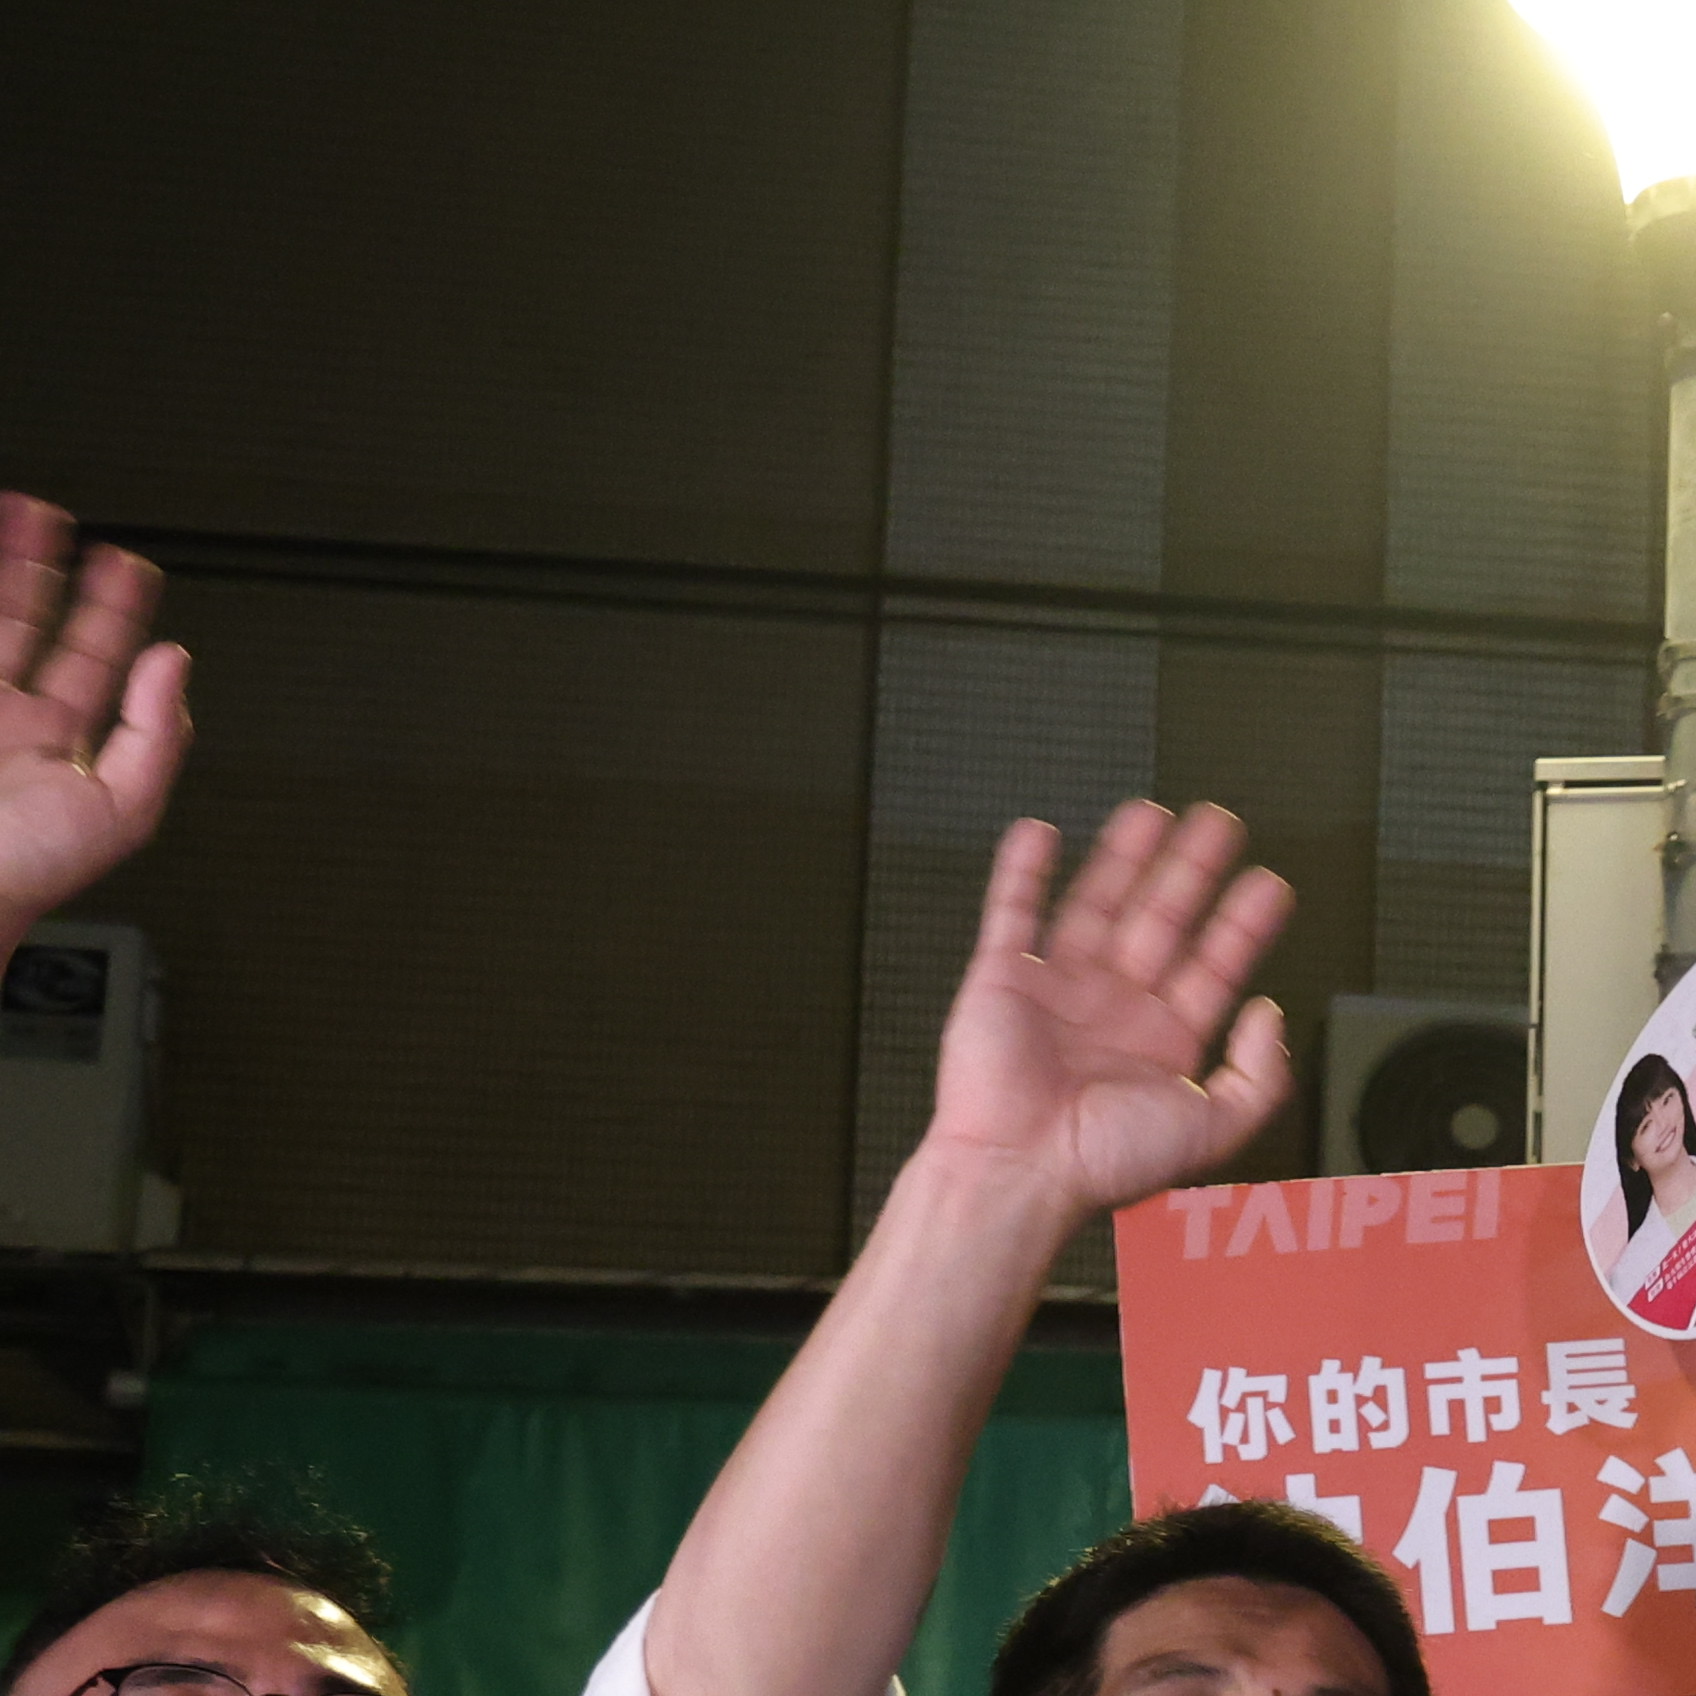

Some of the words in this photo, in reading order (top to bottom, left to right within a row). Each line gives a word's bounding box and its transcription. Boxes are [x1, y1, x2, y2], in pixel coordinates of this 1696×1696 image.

[1166, 1170, 1500, 1260] TAIPEI
[1187, 1337, 1638, 1464] 你的市長
